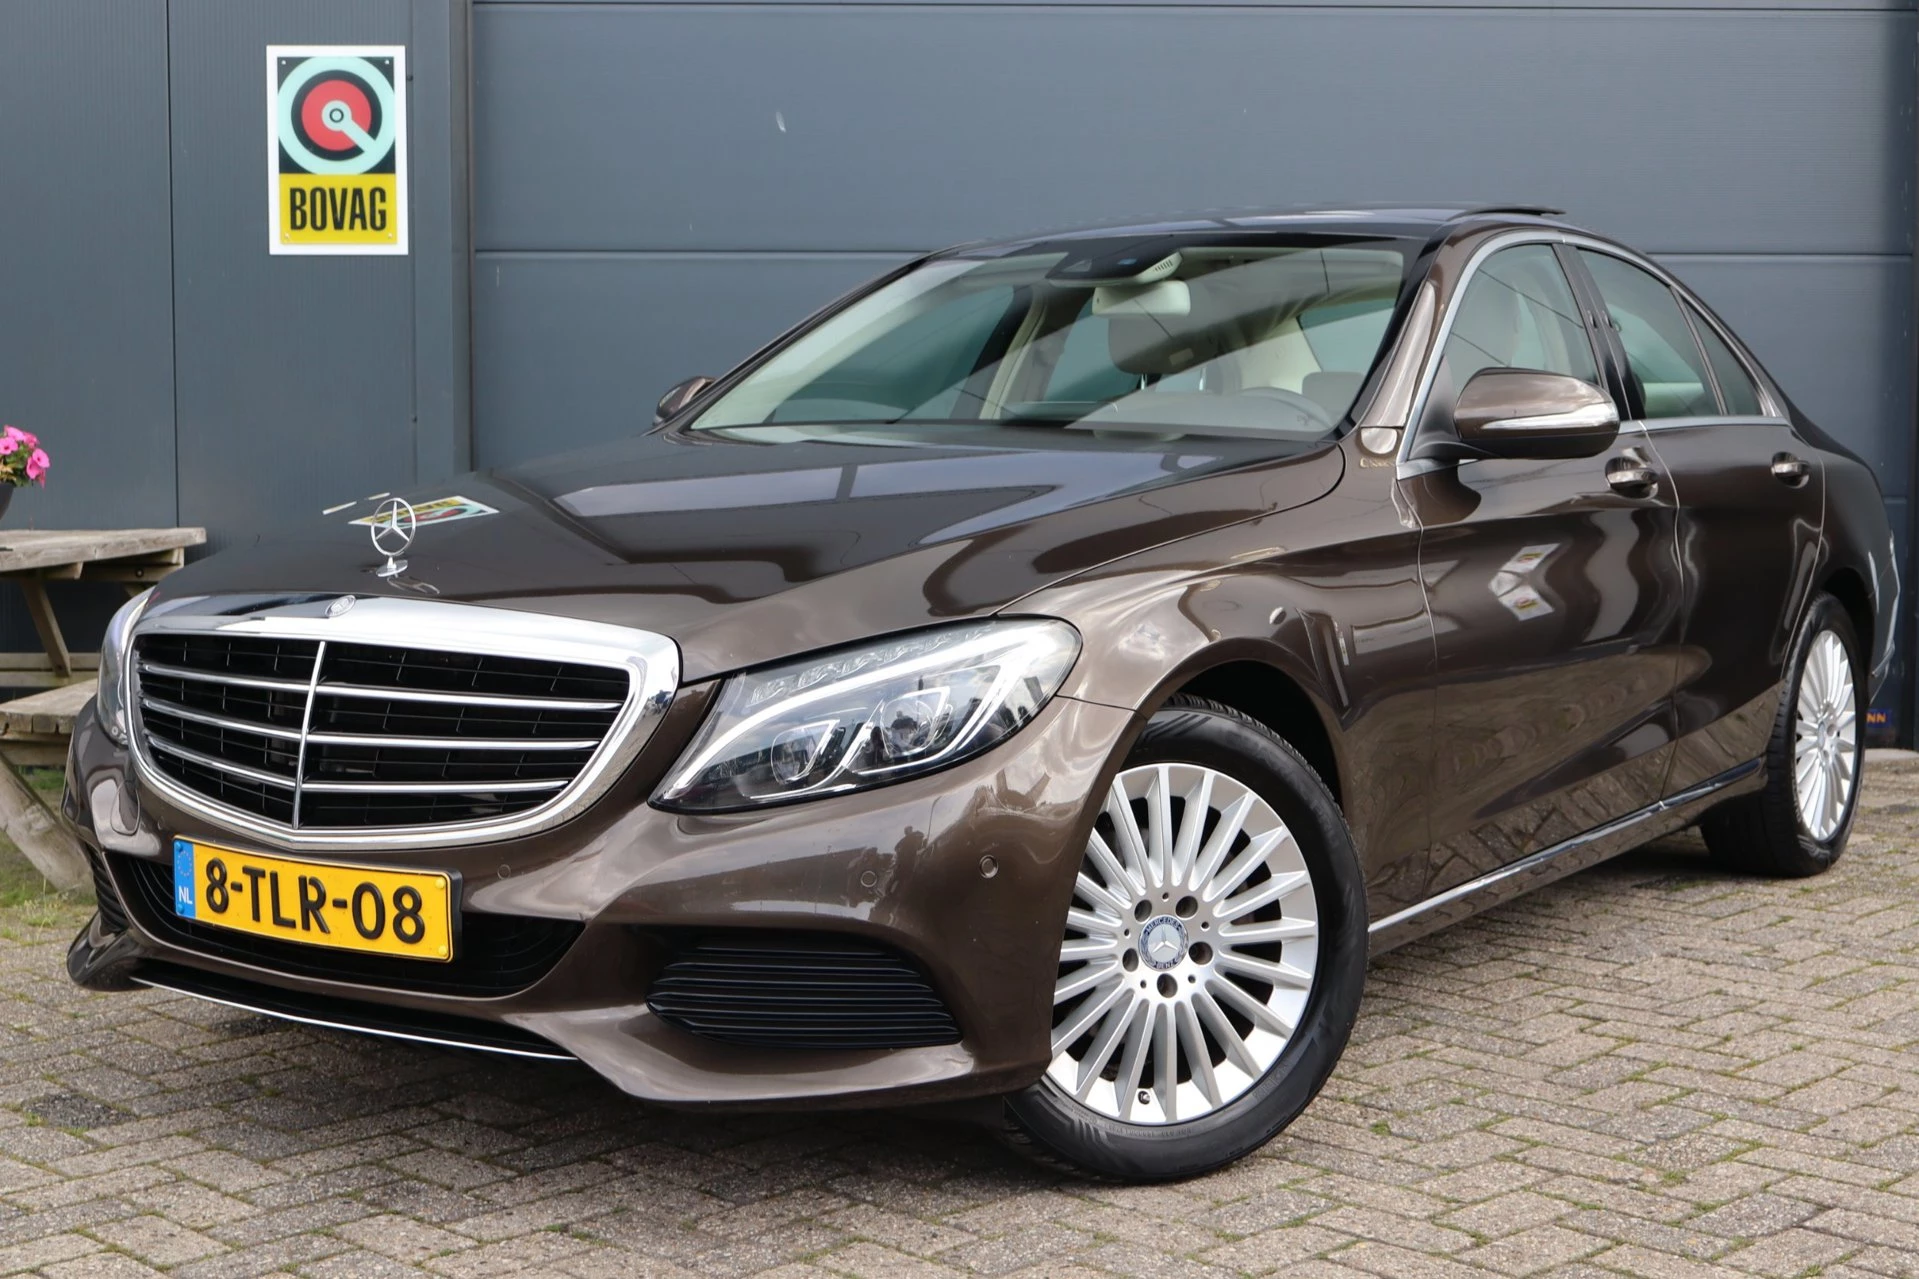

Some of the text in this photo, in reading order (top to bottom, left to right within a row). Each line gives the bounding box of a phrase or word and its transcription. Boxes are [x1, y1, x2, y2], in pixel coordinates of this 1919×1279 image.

[289, 187, 387, 231] BOVAG
[178, 885, 193, 905] NL
[205, 857, 426, 944] 8-TLR-08
[1146, 916, 1180, 933] MERCEDES
